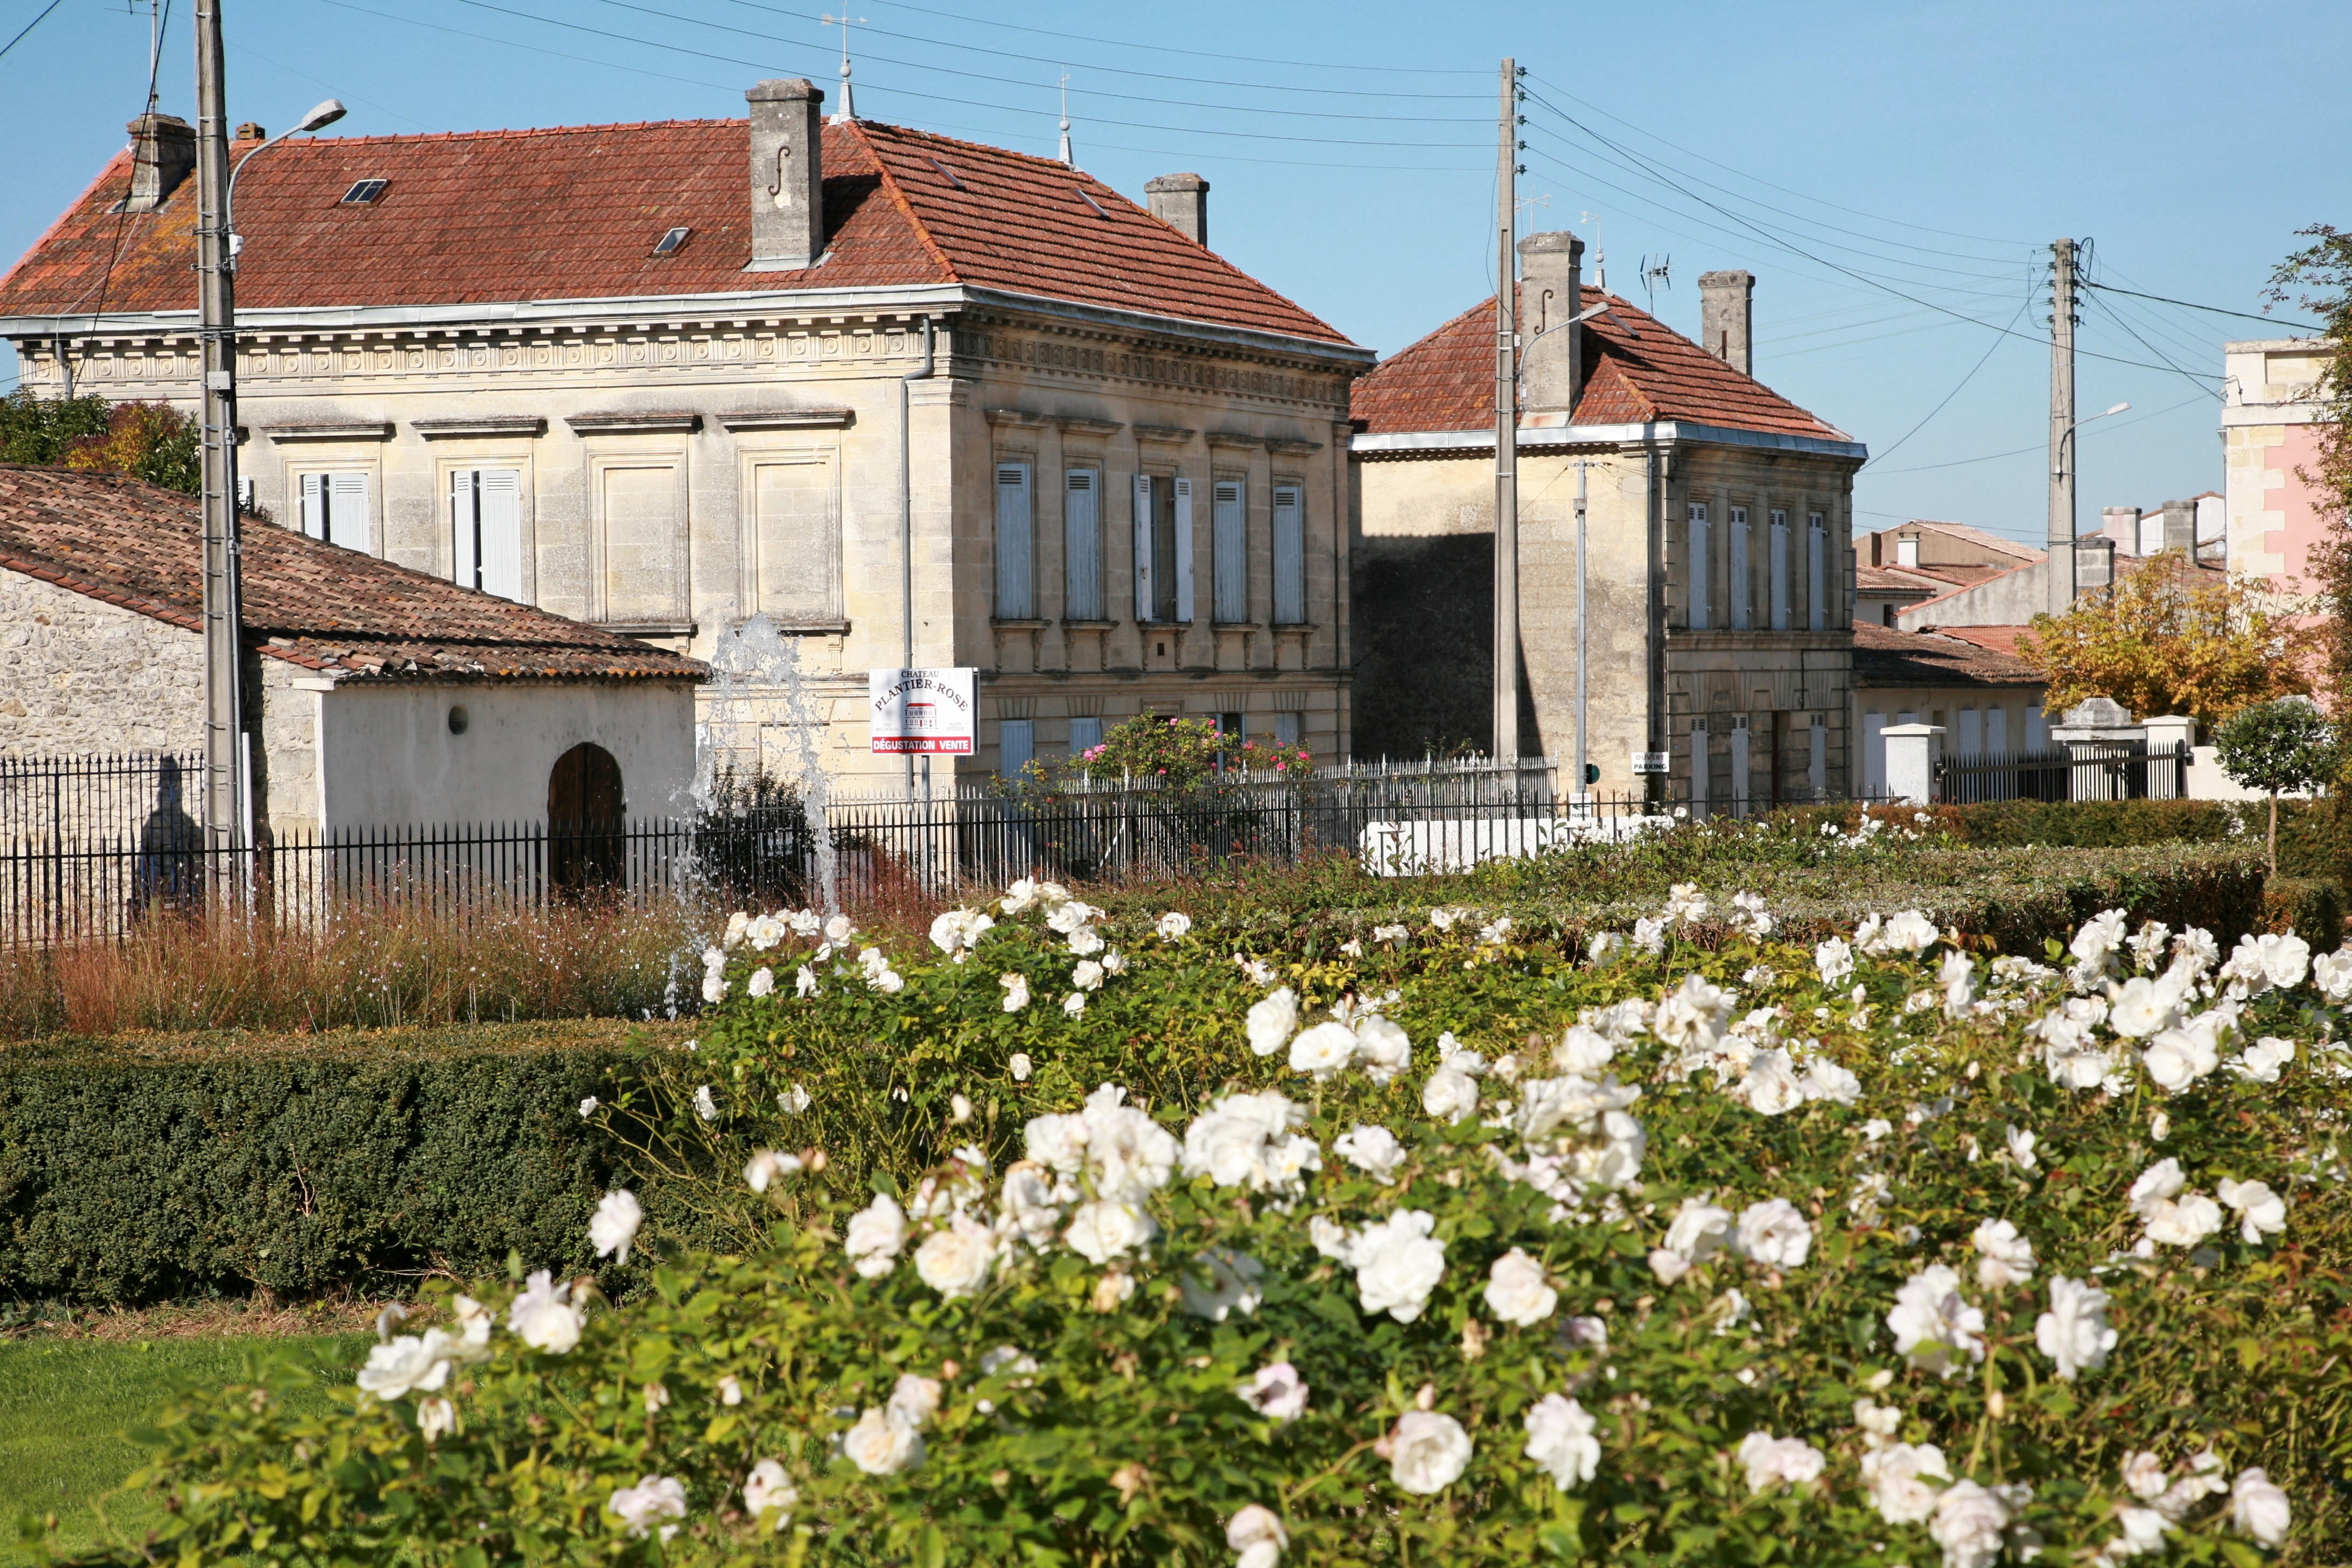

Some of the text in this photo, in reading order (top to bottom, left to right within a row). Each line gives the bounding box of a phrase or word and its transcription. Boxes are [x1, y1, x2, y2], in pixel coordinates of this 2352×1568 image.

[874, 679, 968, 712] PLANTIER-ROSE
[873, 738, 969, 750] DÉGUSTATION VENTE
